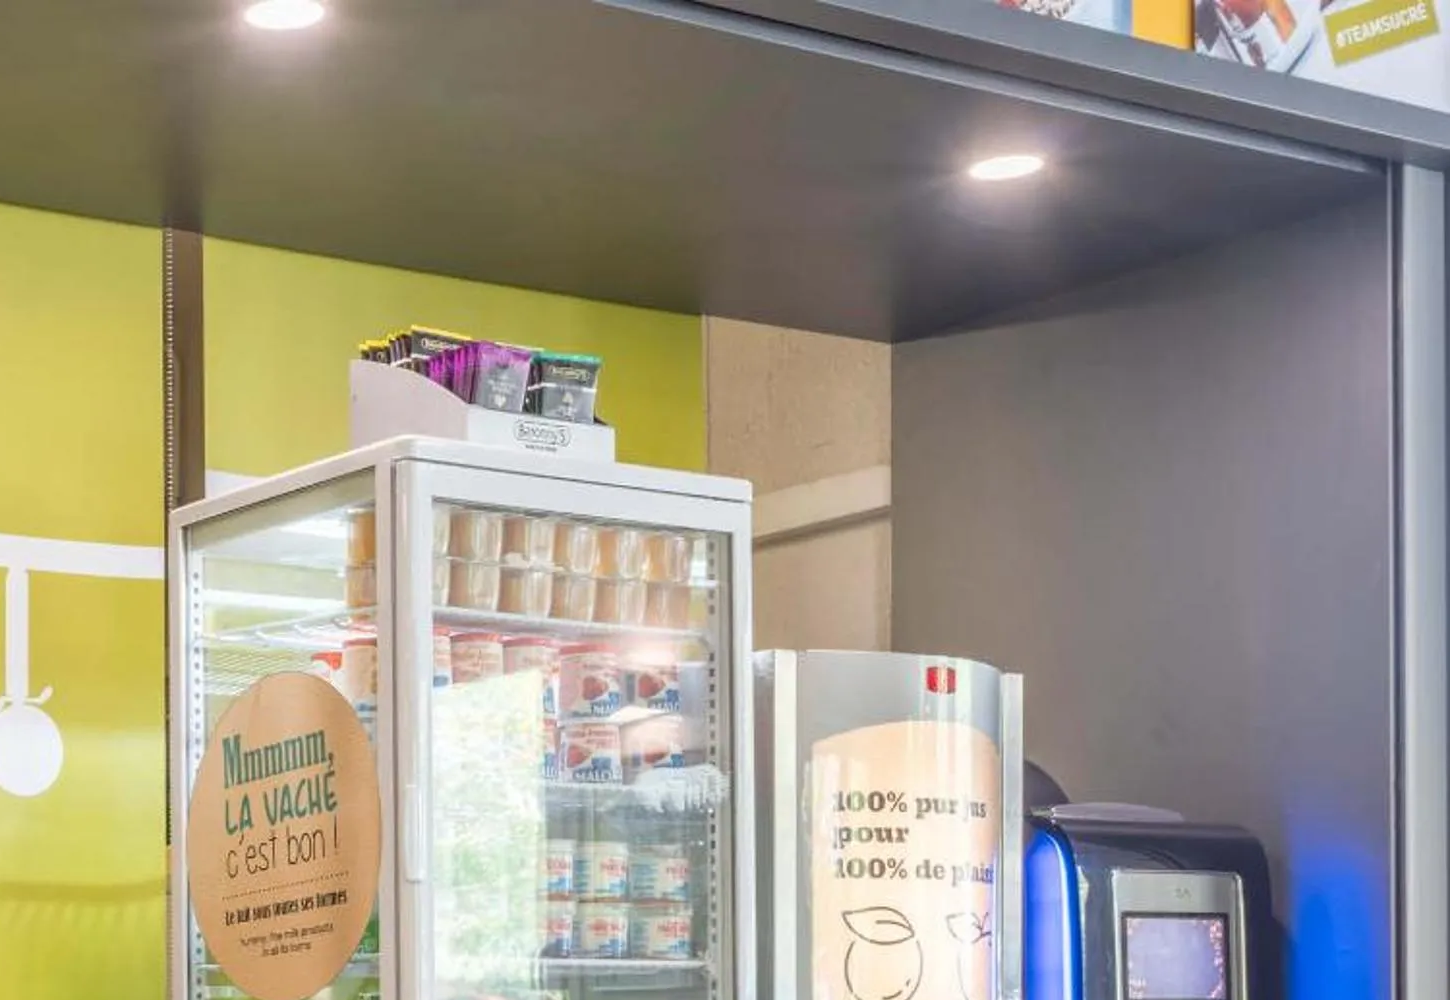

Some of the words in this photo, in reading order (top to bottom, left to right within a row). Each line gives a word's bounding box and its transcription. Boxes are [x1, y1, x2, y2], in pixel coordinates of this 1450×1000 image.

[225, 793, 253, 836] LA
[263, 771, 338, 825] VACHE
[833, 790, 908, 813] 100%
[915, 796, 958, 820] pur
[226, 829, 278, 879] c'est
[286, 826, 326, 865] bon
[833, 825, 910, 850] pour
[834, 857, 908, 880] 100%
[915, 858, 946, 880] de
